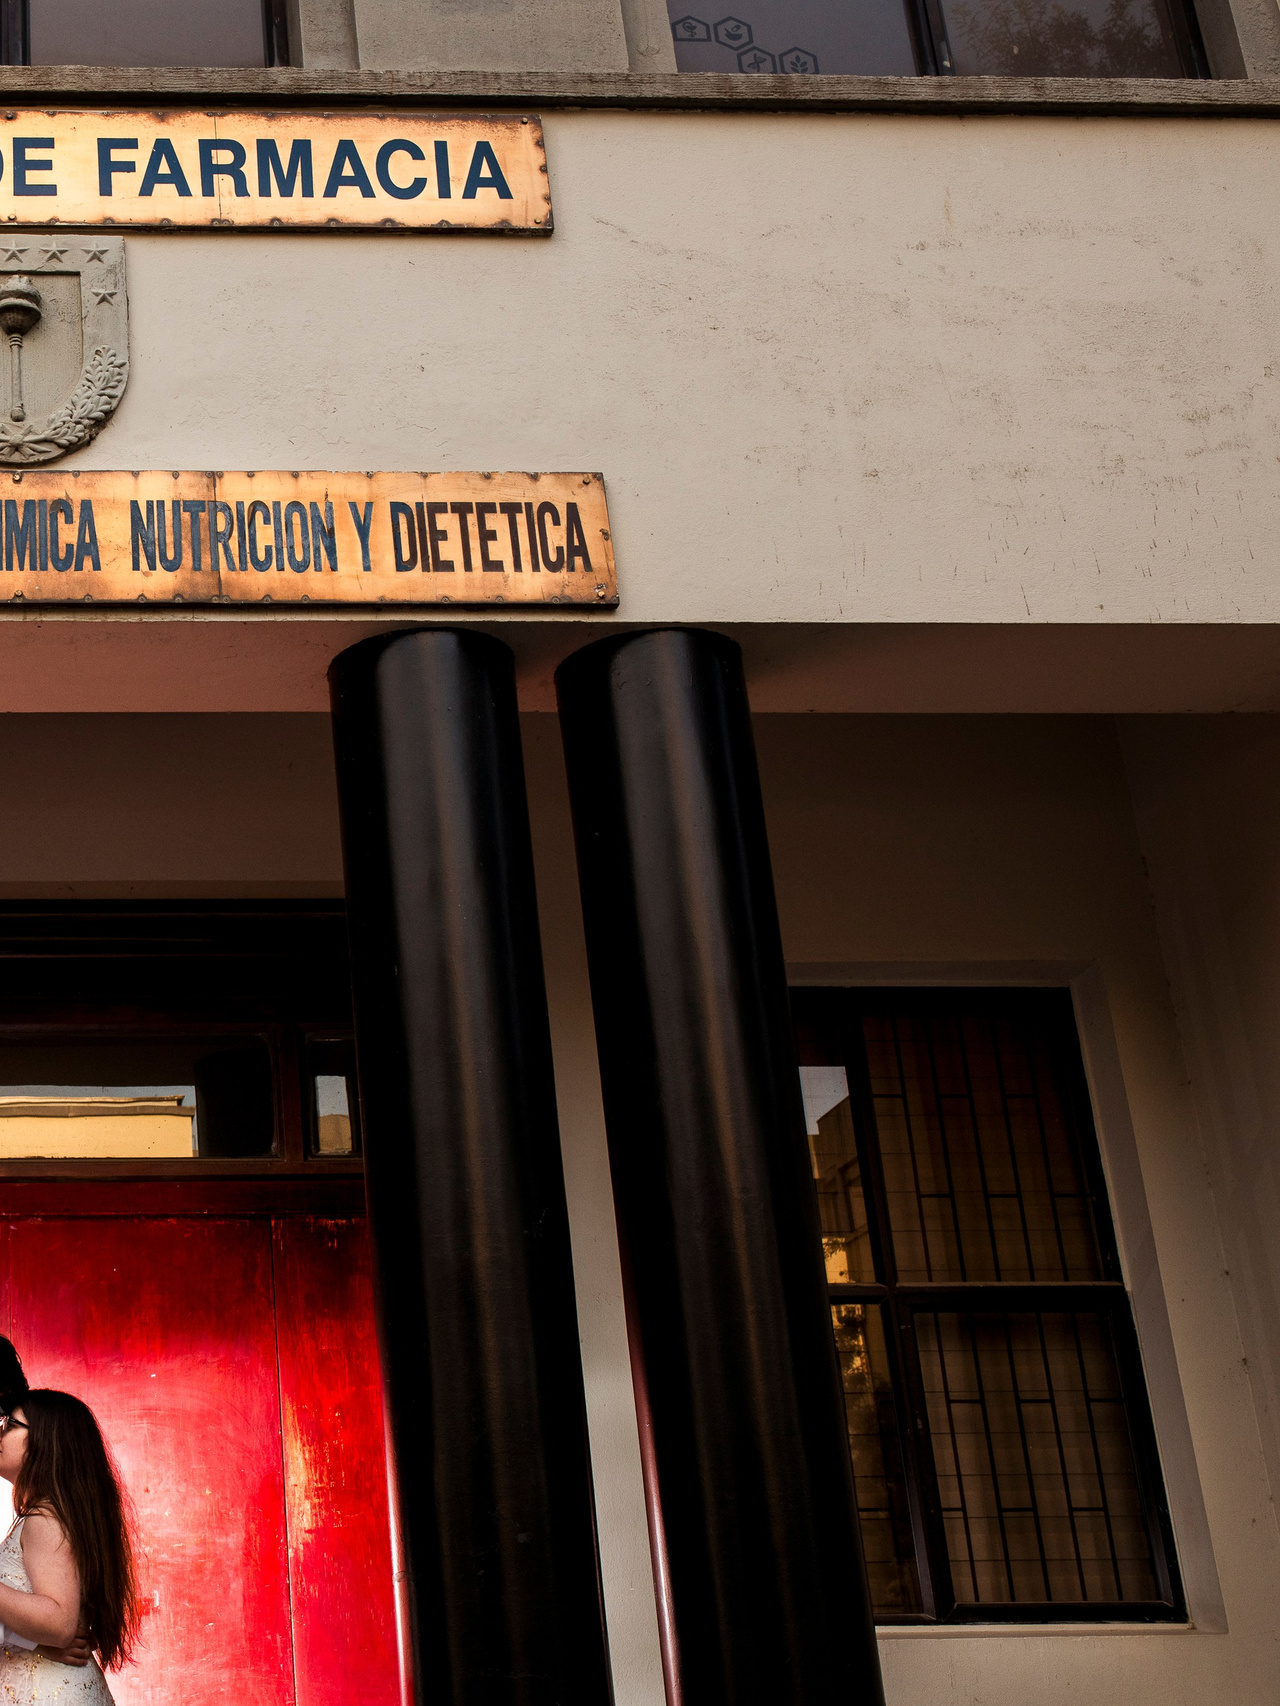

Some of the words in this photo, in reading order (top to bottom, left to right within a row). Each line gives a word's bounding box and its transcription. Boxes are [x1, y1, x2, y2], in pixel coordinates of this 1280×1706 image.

[97, 137, 514, 200] FARMACIA
[130, 499, 340, 572] NUTRICION
[348, 501, 374, 572] Y
[390, 501, 593, 572] DIETETICA
